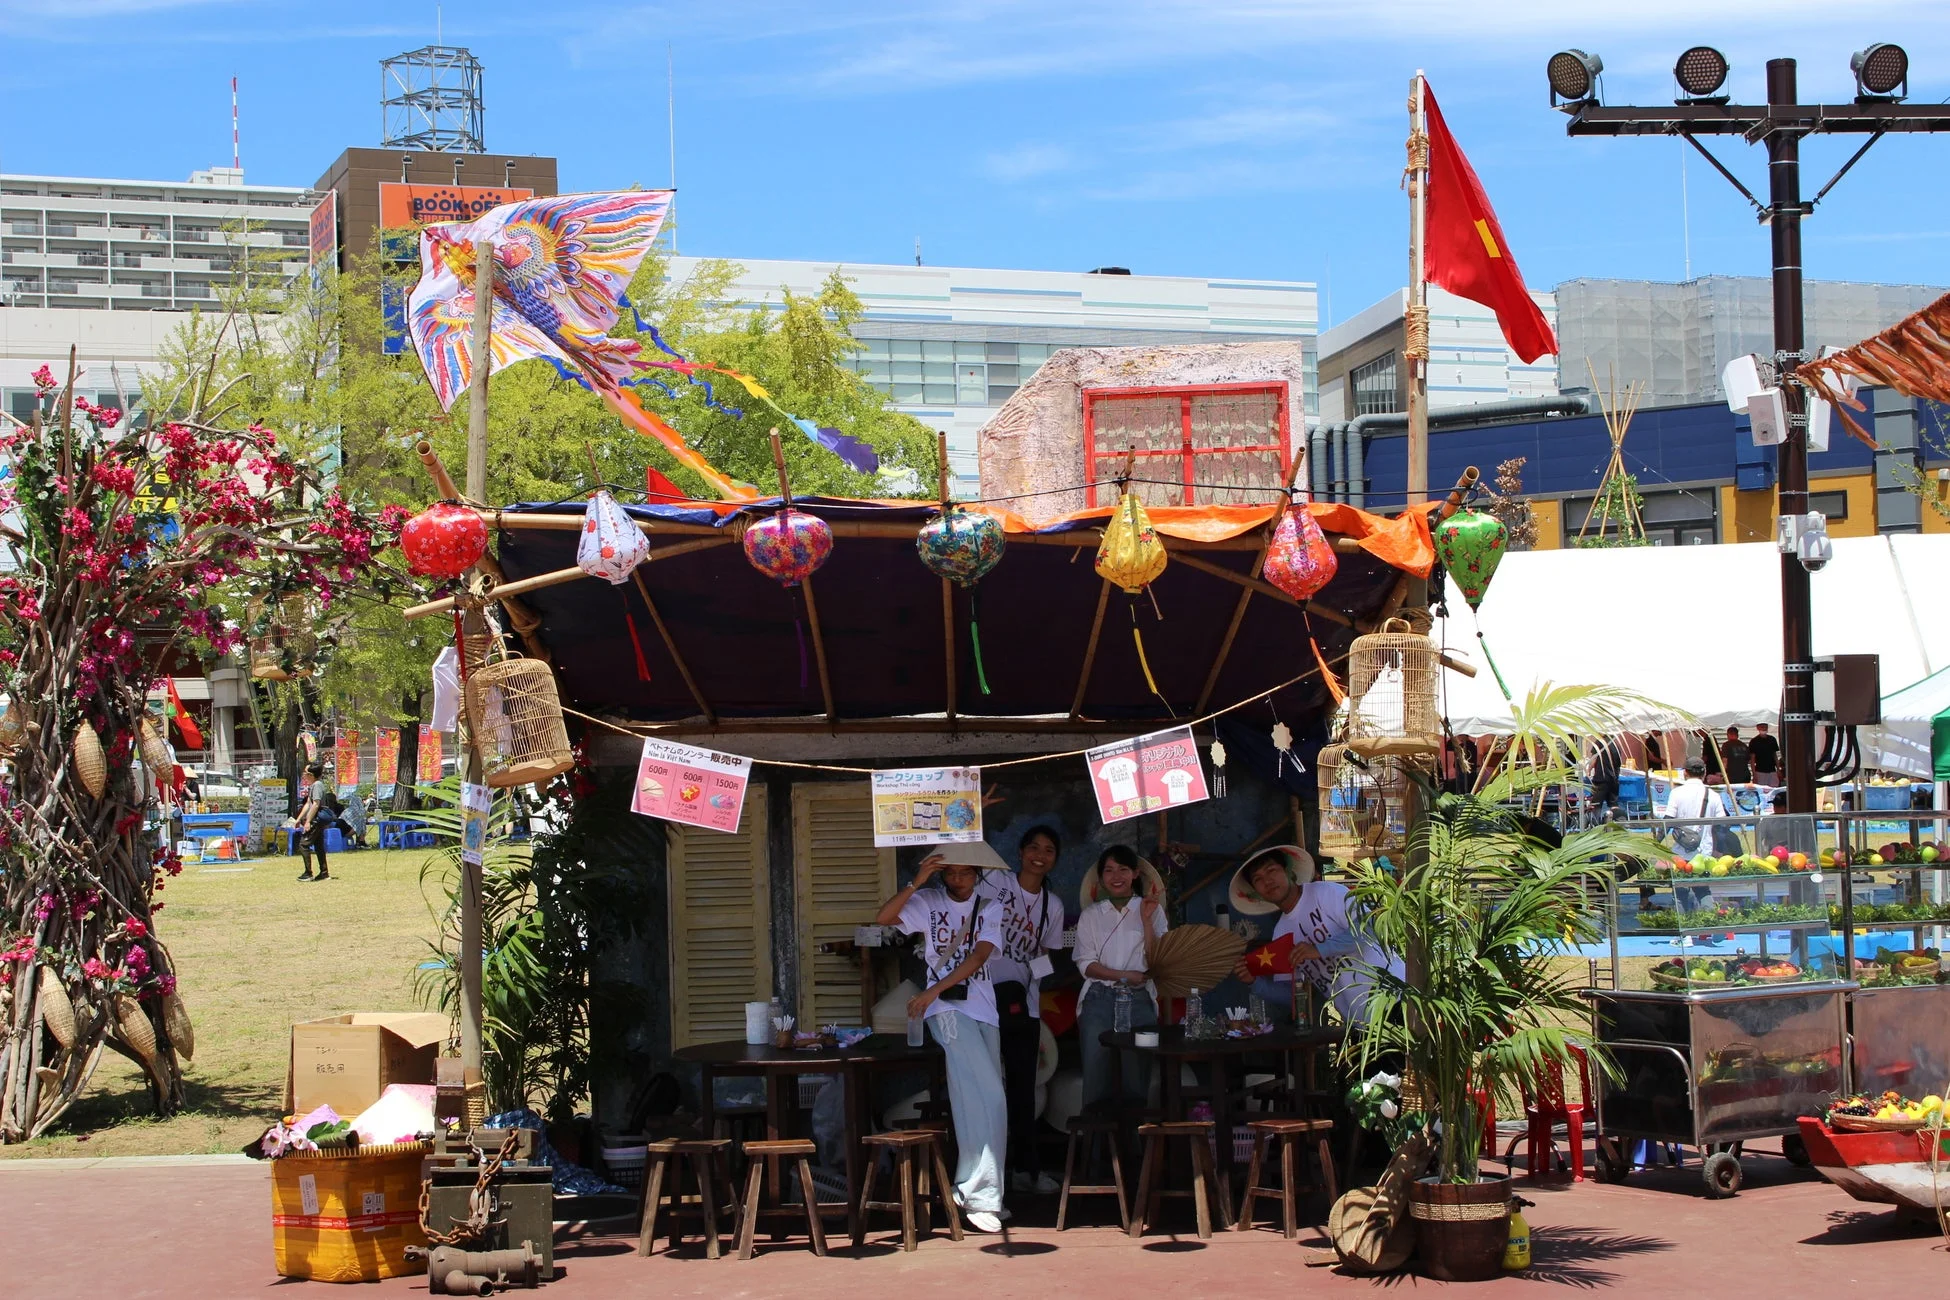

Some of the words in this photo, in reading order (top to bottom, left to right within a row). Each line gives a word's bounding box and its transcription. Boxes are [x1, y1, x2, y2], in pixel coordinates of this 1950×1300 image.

[650, 742, 742, 767] ベトナムのノンラー販売中
[1142, 745, 1186, 763] オリジナル
[648, 764, 668, 776] 600円
[874, 770, 945, 782] ワークショップ
[683, 771, 703, 783] 600円
[715, 778, 739, 789] 1500円
